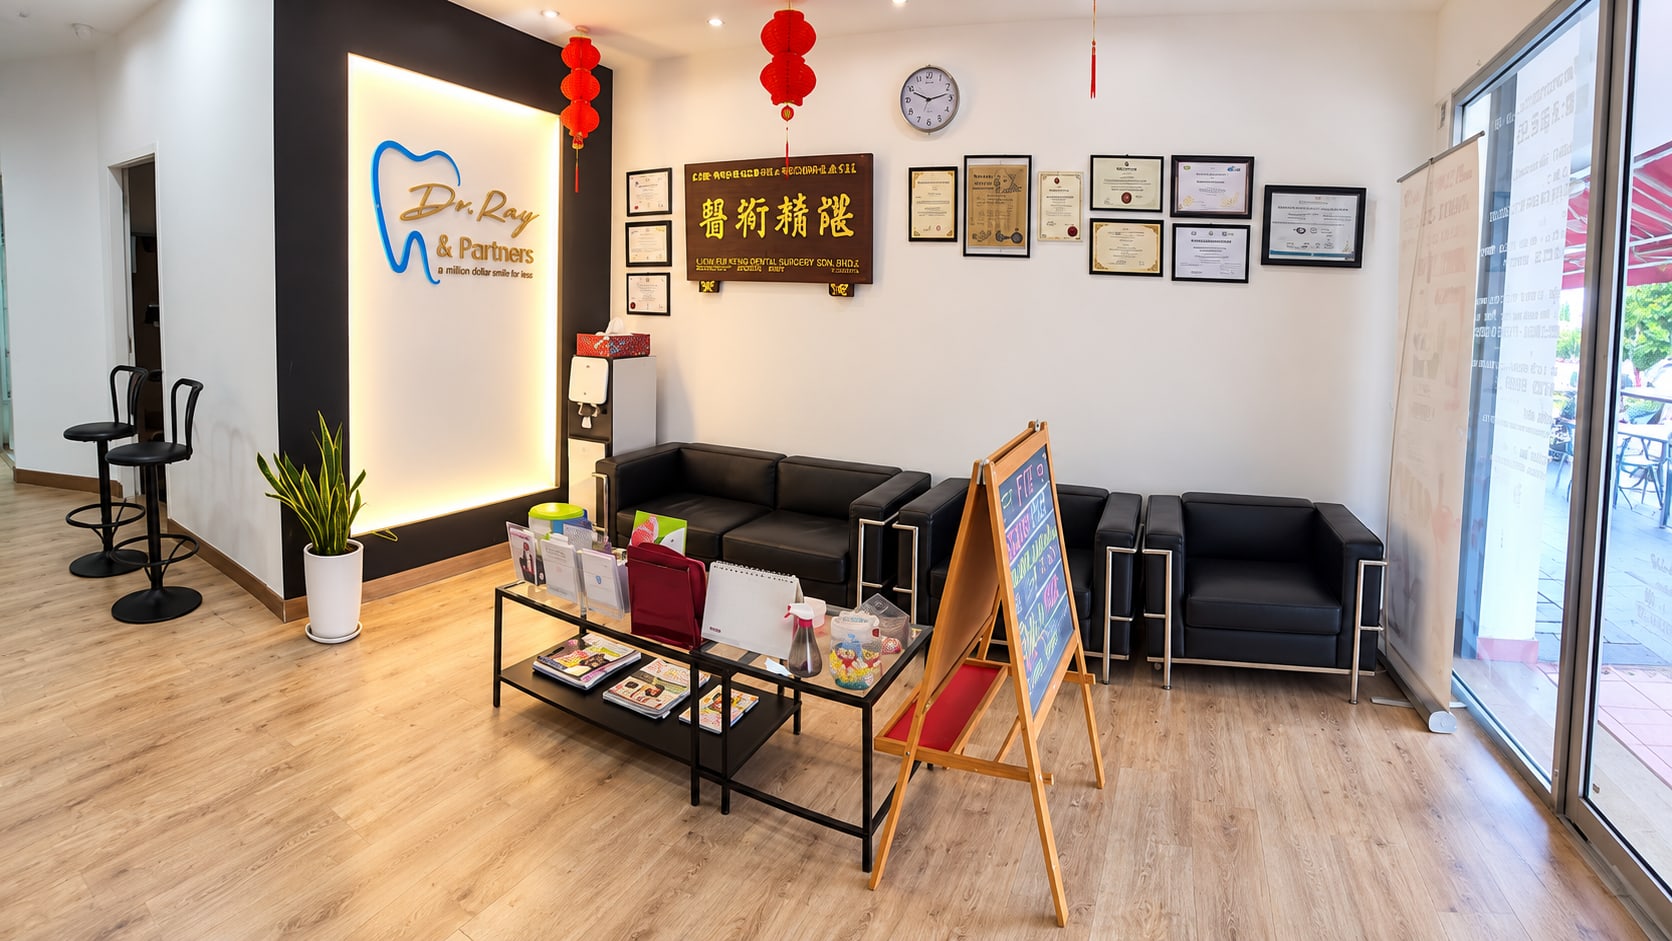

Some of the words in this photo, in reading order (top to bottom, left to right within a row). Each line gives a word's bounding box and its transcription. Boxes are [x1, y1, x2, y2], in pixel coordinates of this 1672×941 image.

[400, 183, 473, 221] Dr.
[476, 190, 541, 239] Ray
[436, 234, 453, 258] &
[459, 236, 535, 264] Partners
[437, 266, 444, 275] a
[446, 265, 470, 276] million
[472, 266, 491, 277] dollar
[492, 269, 510, 278] smile
[511, 269, 520, 279] for
[521, 271, 533, 280] less
